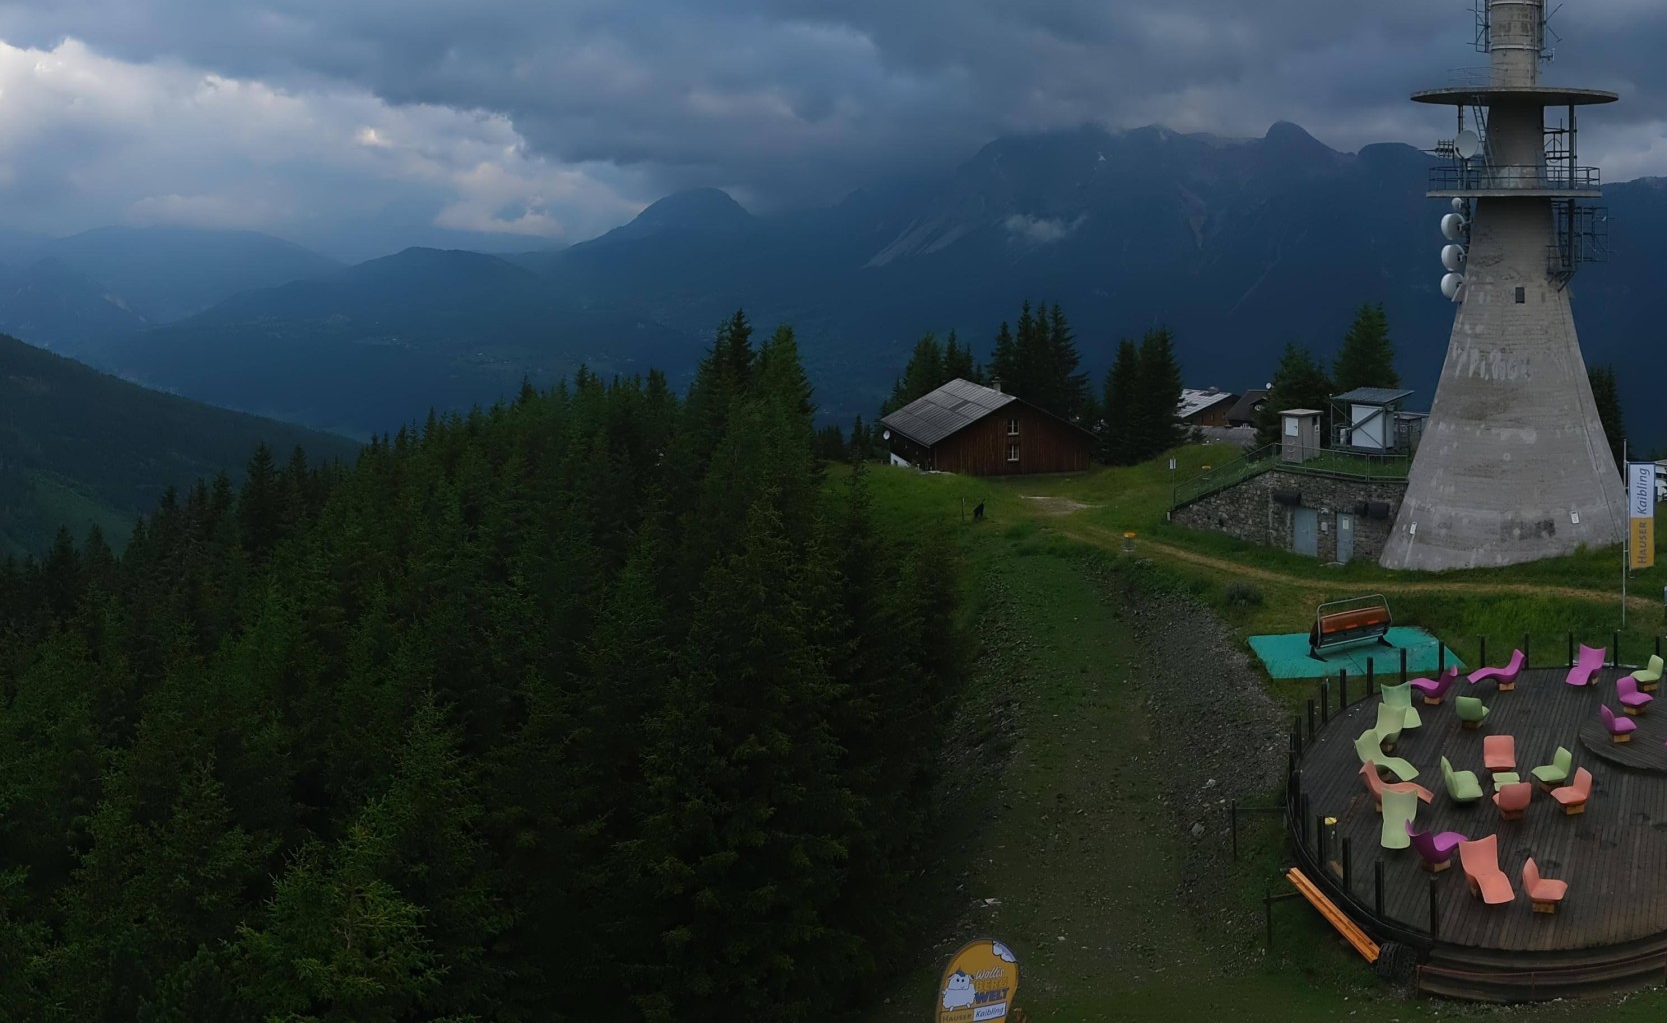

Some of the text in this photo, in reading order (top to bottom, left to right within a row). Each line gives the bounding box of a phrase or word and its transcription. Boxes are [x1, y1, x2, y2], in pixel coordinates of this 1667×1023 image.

[1637, 467, 1650, 564] HAUSER Kaibling
[976, 977, 1009, 991] BERG
[975, 1007, 1004, 1018] Kaibling
